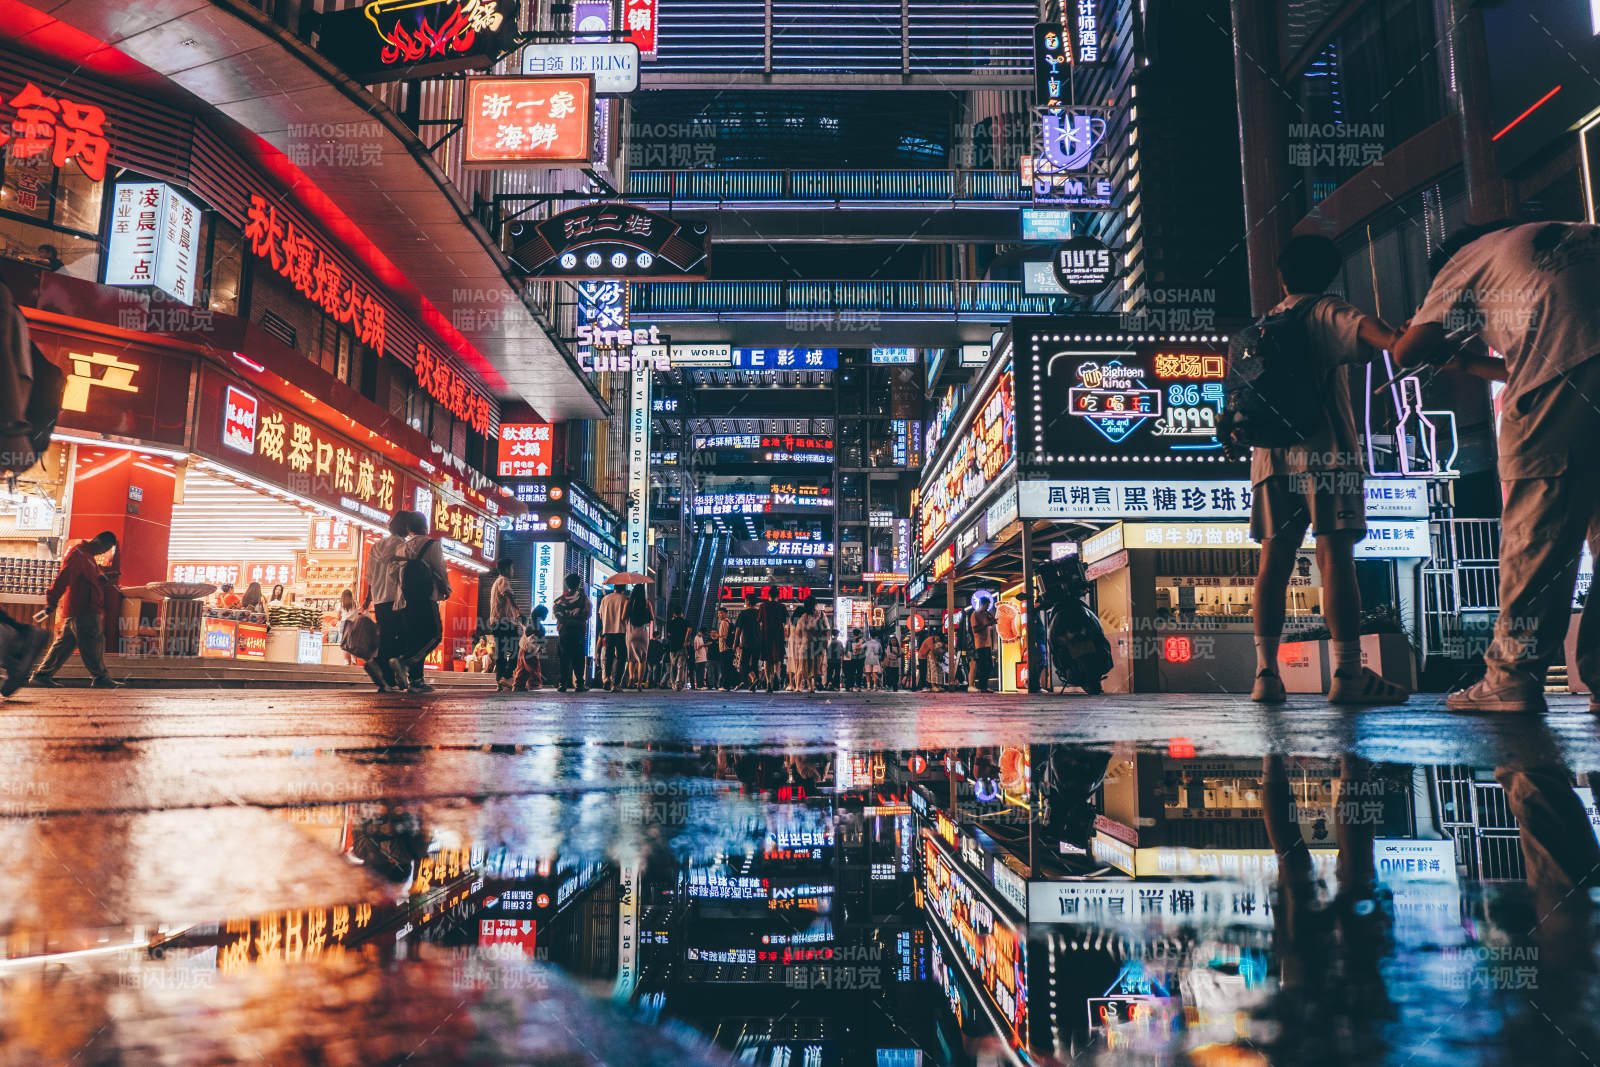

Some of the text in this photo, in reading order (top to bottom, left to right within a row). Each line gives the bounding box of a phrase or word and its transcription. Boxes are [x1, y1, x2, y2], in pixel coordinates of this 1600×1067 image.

[530, 56, 630, 71] 白领 BE BLING
[482, 91, 576, 119] 浙一家
[496, 122, 559, 150] 海鲜
[1035, 181, 1112, 195] UME
[114, 189, 134, 234] 营业至
[130, 187, 159, 280] 凌晨三点
[564, 214, 652, 238] 红二娃
[173, 205, 194, 296] 凌晨三点
[1061, 250, 1109, 268] NUTS
[578, 325, 660, 346] Street
[578, 350, 671, 372] Cuisine
[778, 350, 823, 366] 影城
[1155, 354, 1225, 378] 较场口
[1102, 366, 1144, 379] Eighteen
[636, 390, 643, 400] YI
[1169, 384, 1225, 415] 86号
[635, 408, 643, 443] WORLD
[1101, 418, 1129, 426] Eat and
[1167, 408, 1214, 427] 1999
[1152, 419, 1188, 436] Since
[256, 412, 395, 511] 磁器口陈麻花
[634, 451, 641, 462] DE
[664, 452, 678, 460] 4F
[775, 494, 796, 504] MK
[1048, 486, 1111, 505] 周朔言
[1395, 488, 1417, 499] 影城
[632, 531, 639, 543] DE
[1393, 528, 1415, 540] 影城
[779, 542, 824, 555] 乐乐台球
[252, 564, 295, 584] 中华老
